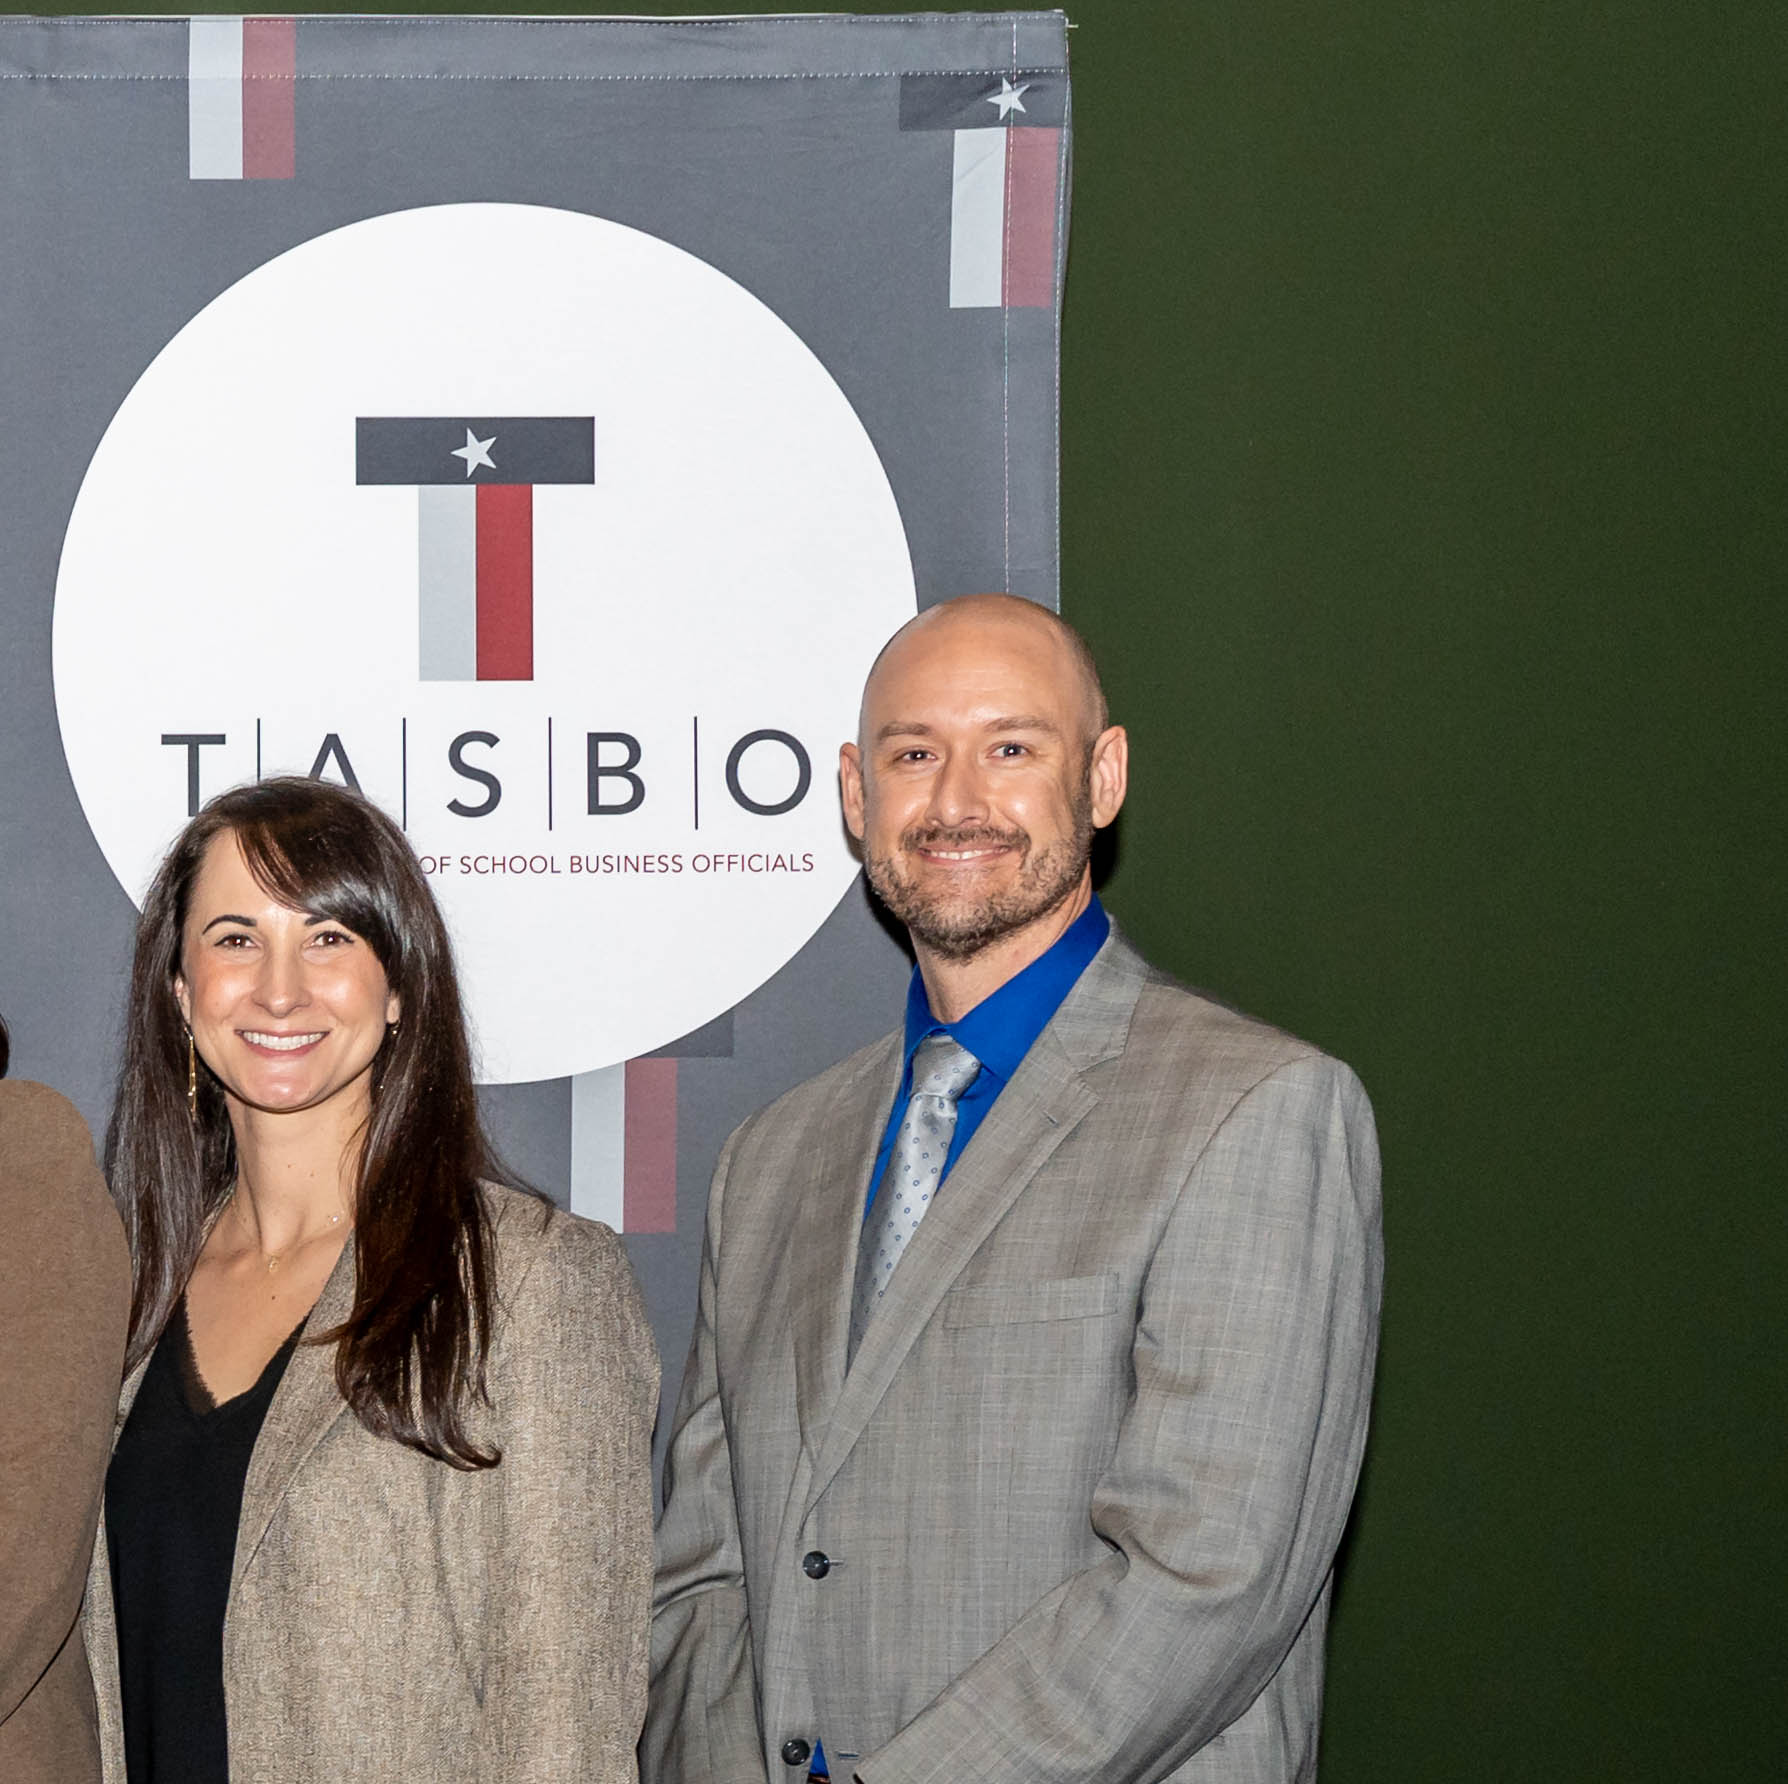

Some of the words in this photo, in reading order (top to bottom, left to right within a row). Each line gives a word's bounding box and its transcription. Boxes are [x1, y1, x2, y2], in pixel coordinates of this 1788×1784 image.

[419, 855, 452, 875] OF
[459, 854, 560, 875] SCHOOL
[569, 854, 684, 874] BUSINESS
[692, 853, 815, 874] OFFICIALS
